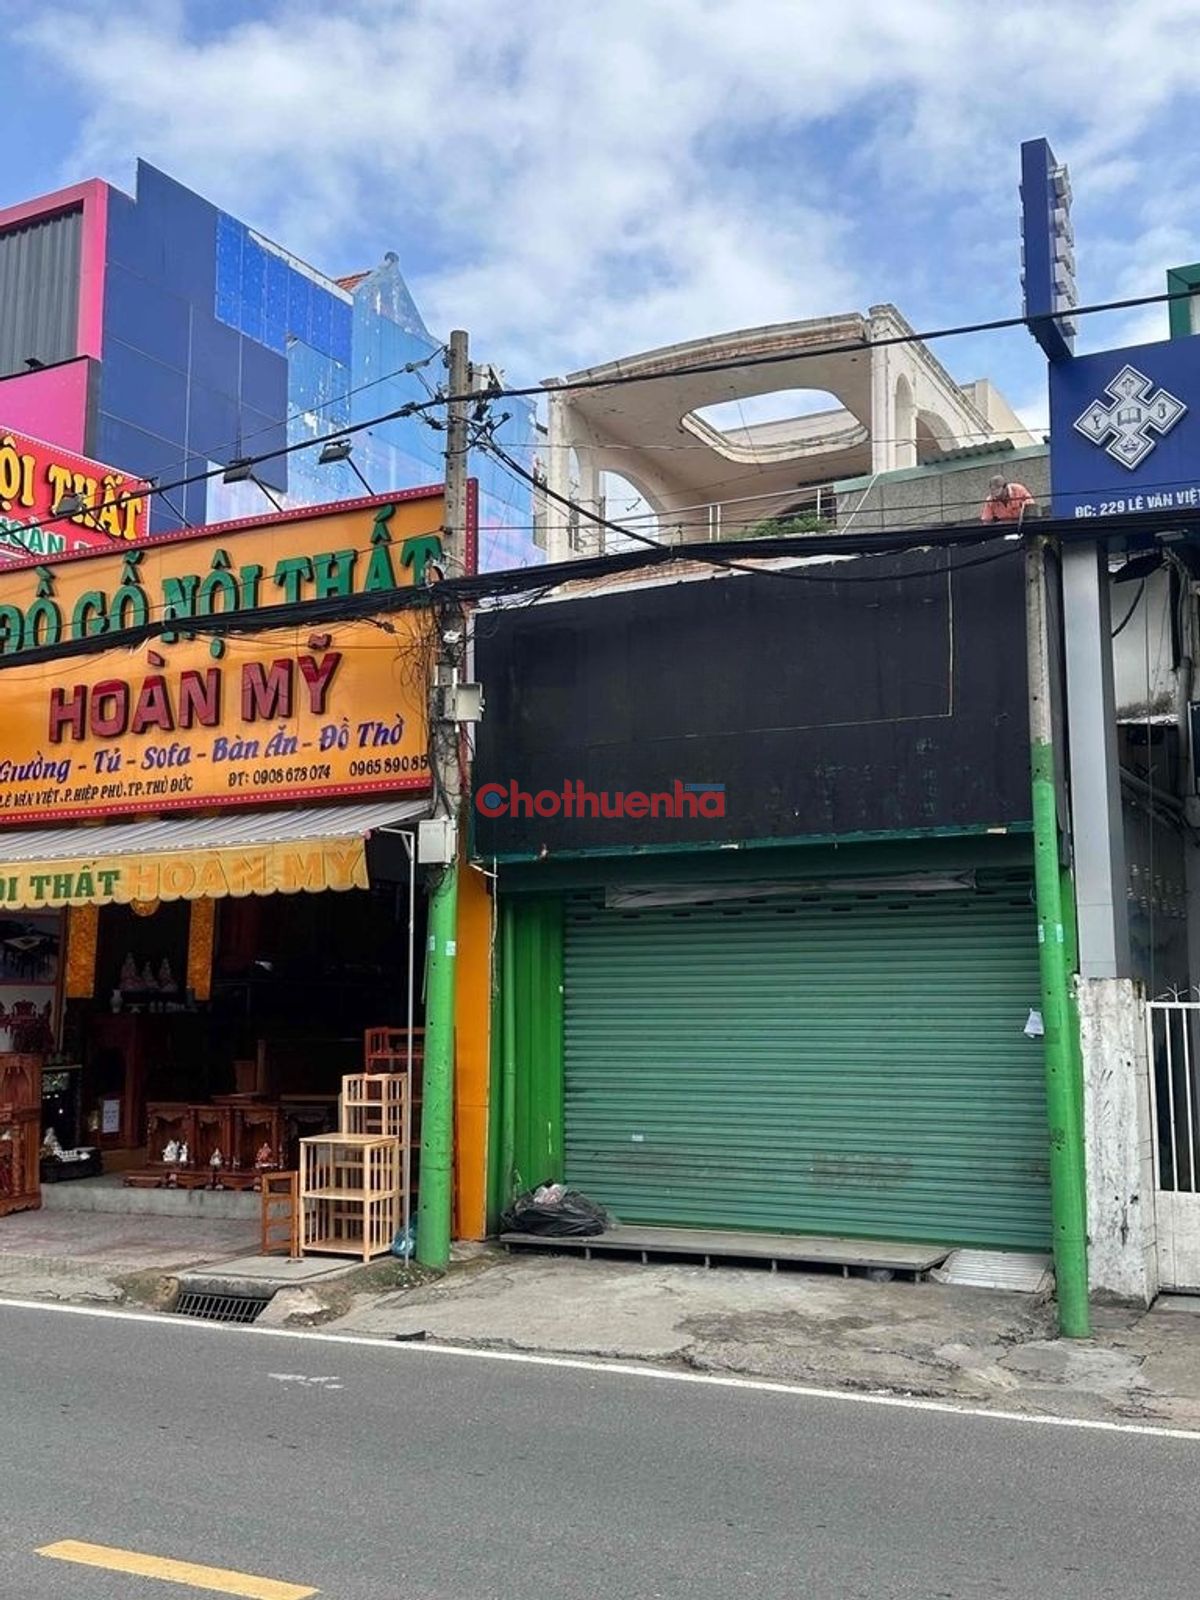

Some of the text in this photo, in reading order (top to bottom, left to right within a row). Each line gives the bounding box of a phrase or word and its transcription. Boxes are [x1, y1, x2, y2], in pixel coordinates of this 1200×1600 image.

[48, 463, 142, 541] THẤT
[1100, 499, 1125, 516] 229
[1128, 495, 1145, 511] LÊ
[1147, 492, 1173, 508] VĂN
[72, 550, 149, 640] GỖ
[161, 549, 262, 660] NỘI
[274, 503, 443, 603] THẤT
[49, 633, 343, 744] HOÀN MỸ
[93, 748, 121, 775] Tủ
[141, 742, 192, 770] Sofa
[212, 735, 260, 763] Bàn
[264, 725, 298, 758] Ăn
[319, 717, 350, 752] Đồ
[357, 714, 405, 748] Thờ
[170, 773, 193, 793] ĐỨC
[30, 861, 120, 901] THẤT
[127, 850, 267, 896] HOÀN
